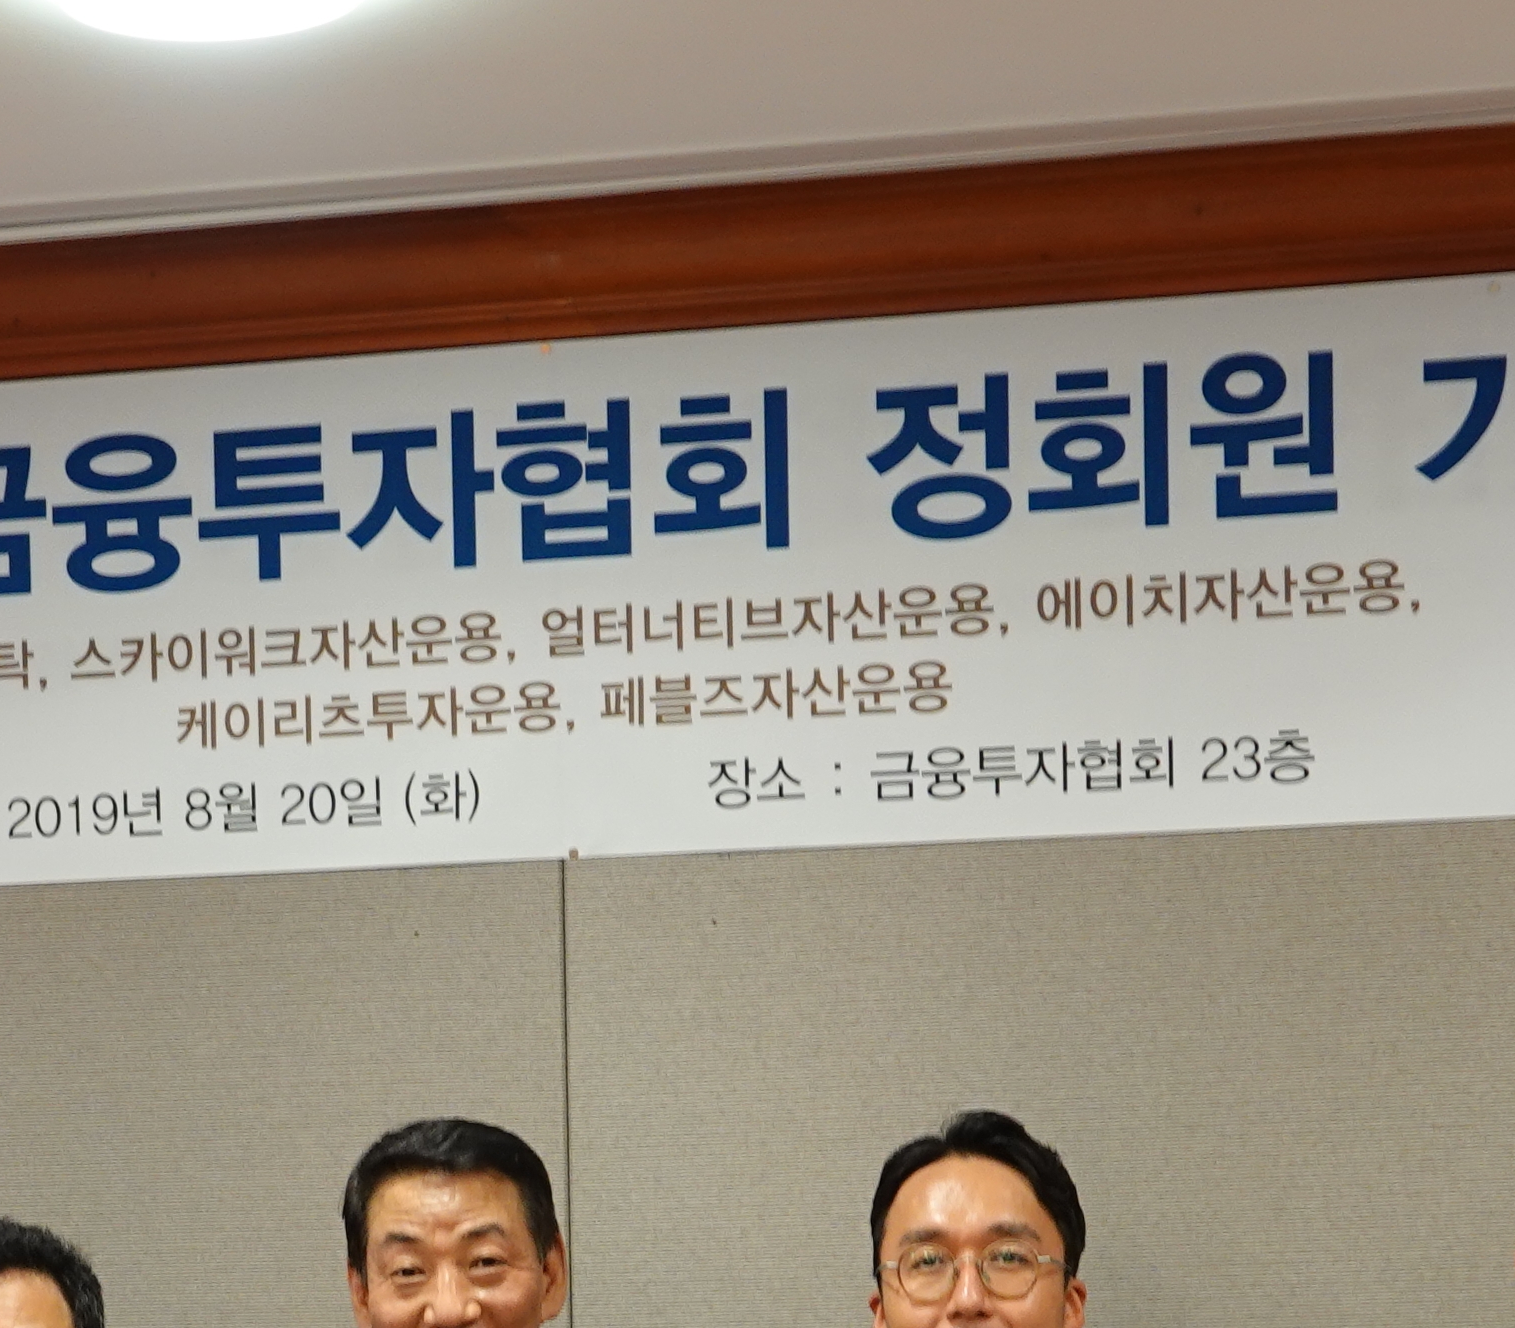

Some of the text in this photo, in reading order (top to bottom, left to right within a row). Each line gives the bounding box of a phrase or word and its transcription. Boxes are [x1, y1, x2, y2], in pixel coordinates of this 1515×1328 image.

[866, 349, 1338, 541] 정회원
[70, 610, 516, 683] 스카이워크자산운용,
[541, 582, 1010, 658] 얼터너티브자산운용,
[1036, 558, 1420, 631] 에이치자산운용,
[177, 659, 953, 750] 케이리츠투자운용, 페블즈자산운용
[6, 787, 163, 839] 2019년
[184, 781, 258, 833] 8월
[280, 776, 382, 827] 20일
[404, 769, 481, 825] (화)
[707, 729, 1316, 809] 장소 : 금융투자협회 23층
